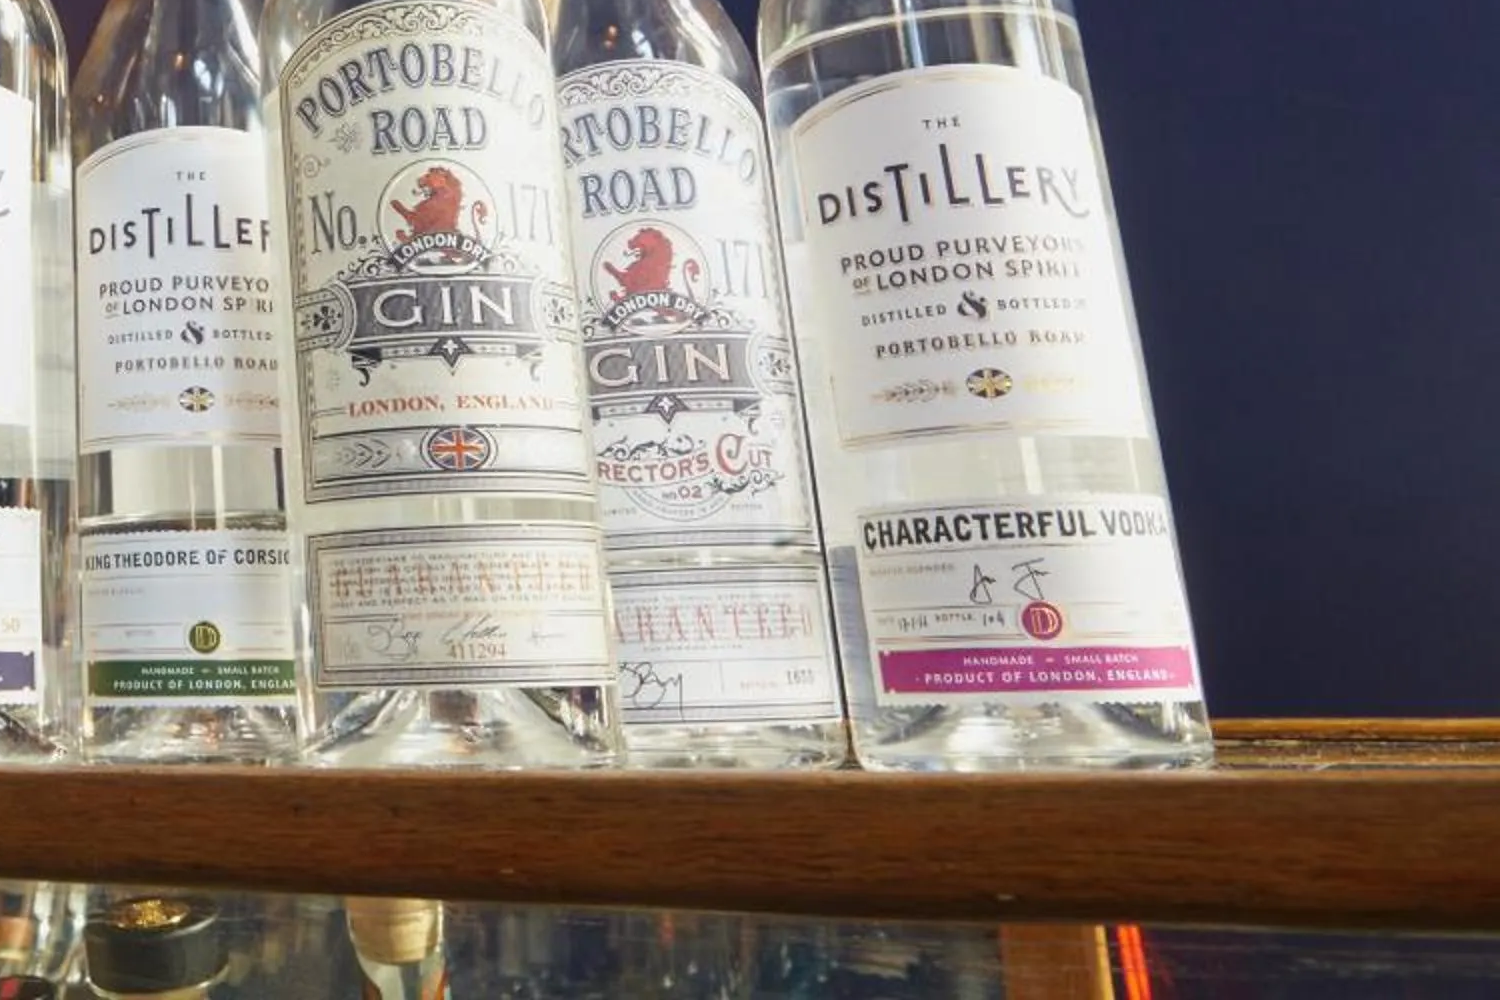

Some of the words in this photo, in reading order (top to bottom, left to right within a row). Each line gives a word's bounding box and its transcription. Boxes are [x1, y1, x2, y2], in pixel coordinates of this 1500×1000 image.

[296, 42, 546, 138] PORTOBELLO
[371, 107, 488, 155] ROAD
[921, 116, 961, 130] THE
[176, 171, 206, 182] THE
[817, 142, 1090, 225] DISTILLERY
[581, 165, 697, 219] ROAD
[395, 233, 458, 267] LONDON
[460, 235, 492, 263] DRY
[840, 243, 925, 275] PROUD
[99, 276, 164, 298] PROUD
[171, 274, 270, 294] PURVEYO
[876, 260, 995, 292] LONDON
[1005, 257, 1082, 280] SPIRIT
[122, 296, 214, 316] LONDON
[222, 295, 274, 314] SPRI
[372, 285, 516, 329] GIN
[607, 292, 672, 326] LONDON
[674, 292, 706, 321] DRY
[860, 304, 948, 328] DISTILLED
[956, 288, 989, 321] &
[180, 320, 205, 345] &
[875, 330, 1018, 360] PORTOBELLO
[115, 356, 225, 374] PORTOBELLO
[589, 342, 734, 389] GIN
[349, 395, 446, 419] LONDON,
[456, 393, 555, 412] ENGLAND
[678, 484, 704, 500] 02
[862, 508, 1096, 552] CHARACTERFUL
[1100, 508, 1169, 538] VODKA
[84, 552, 112, 573] KING
[113, 549, 200, 570] THEODORE
[206, 549, 228, 566] OF
[963, 655, 1035, 668] HANDMADE
[1063, 654, 1103, 666] SMALL
[113, 679, 164, 691] PRODUCT
[167, 678, 184, 690] OF
[188, 678, 247, 691] LONDON,
[924, 671, 995, 686] PRODUCT
[1001, 670, 1023, 684] OF
[1028, 669, 1103, 684] LONDON,
[1106, 668, 1169, 681] ENGLAND
